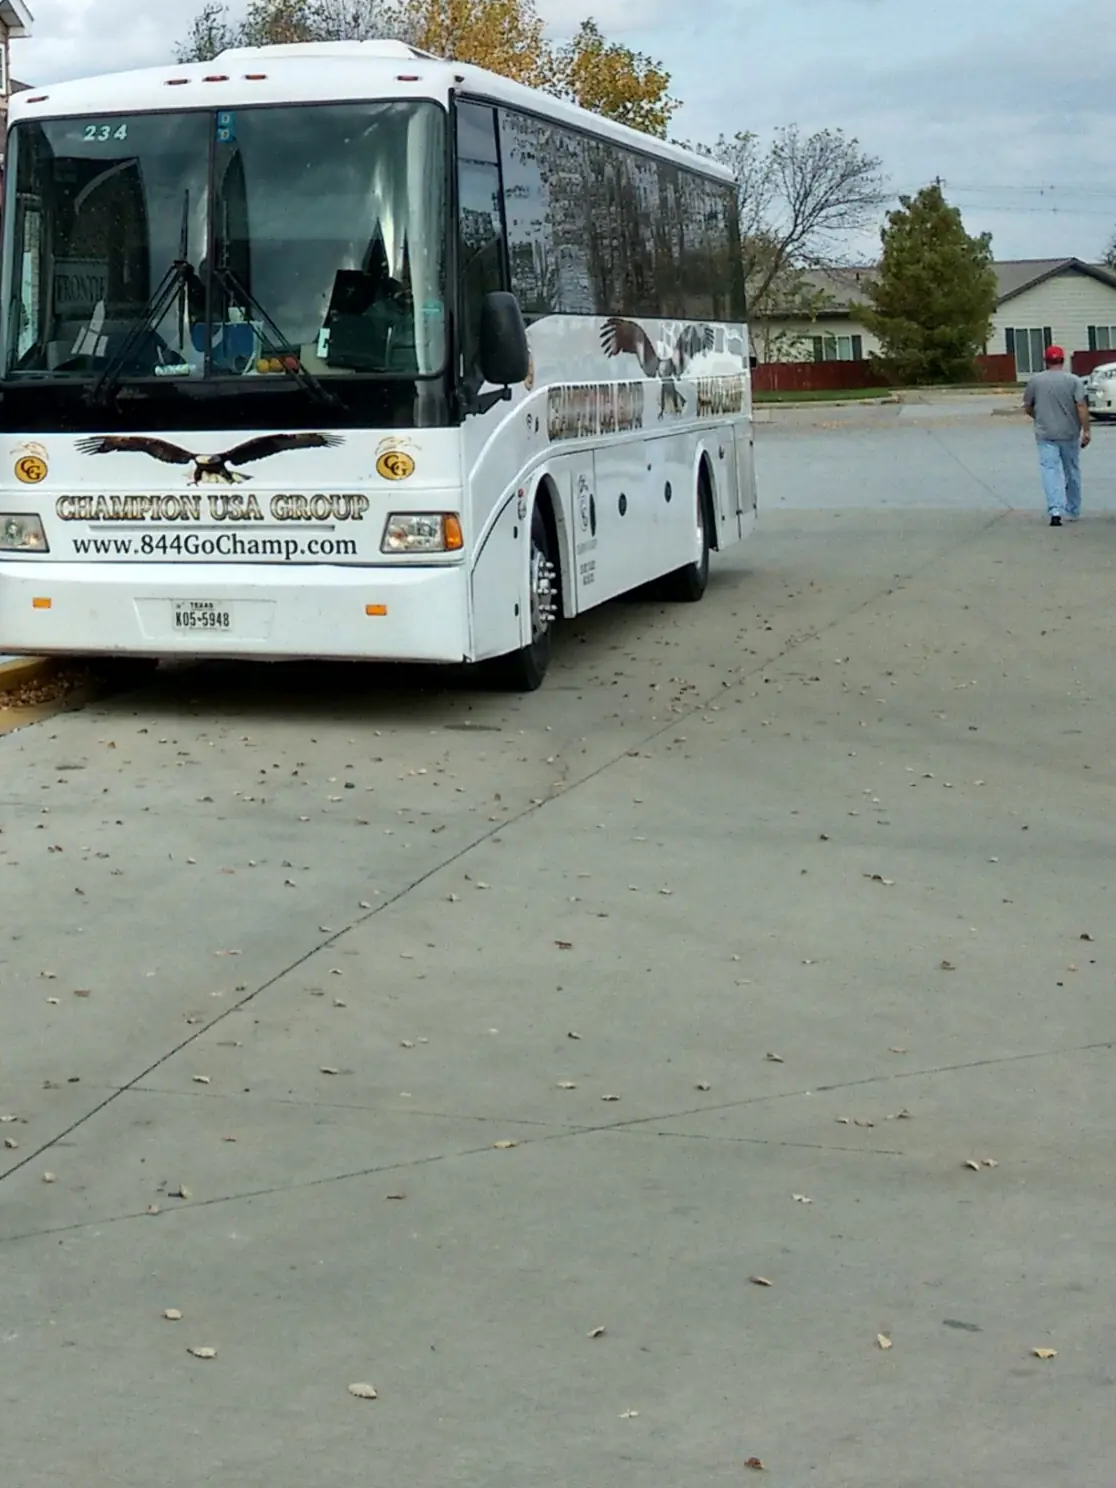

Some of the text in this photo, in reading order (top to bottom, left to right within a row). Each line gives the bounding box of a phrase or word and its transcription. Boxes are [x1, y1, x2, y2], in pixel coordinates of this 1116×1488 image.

[83, 123, 128, 142] 234
[55, 494, 370, 521] CHAMPION USA GROUP
[72, 533, 358, 560] www.844GoChamp.com
